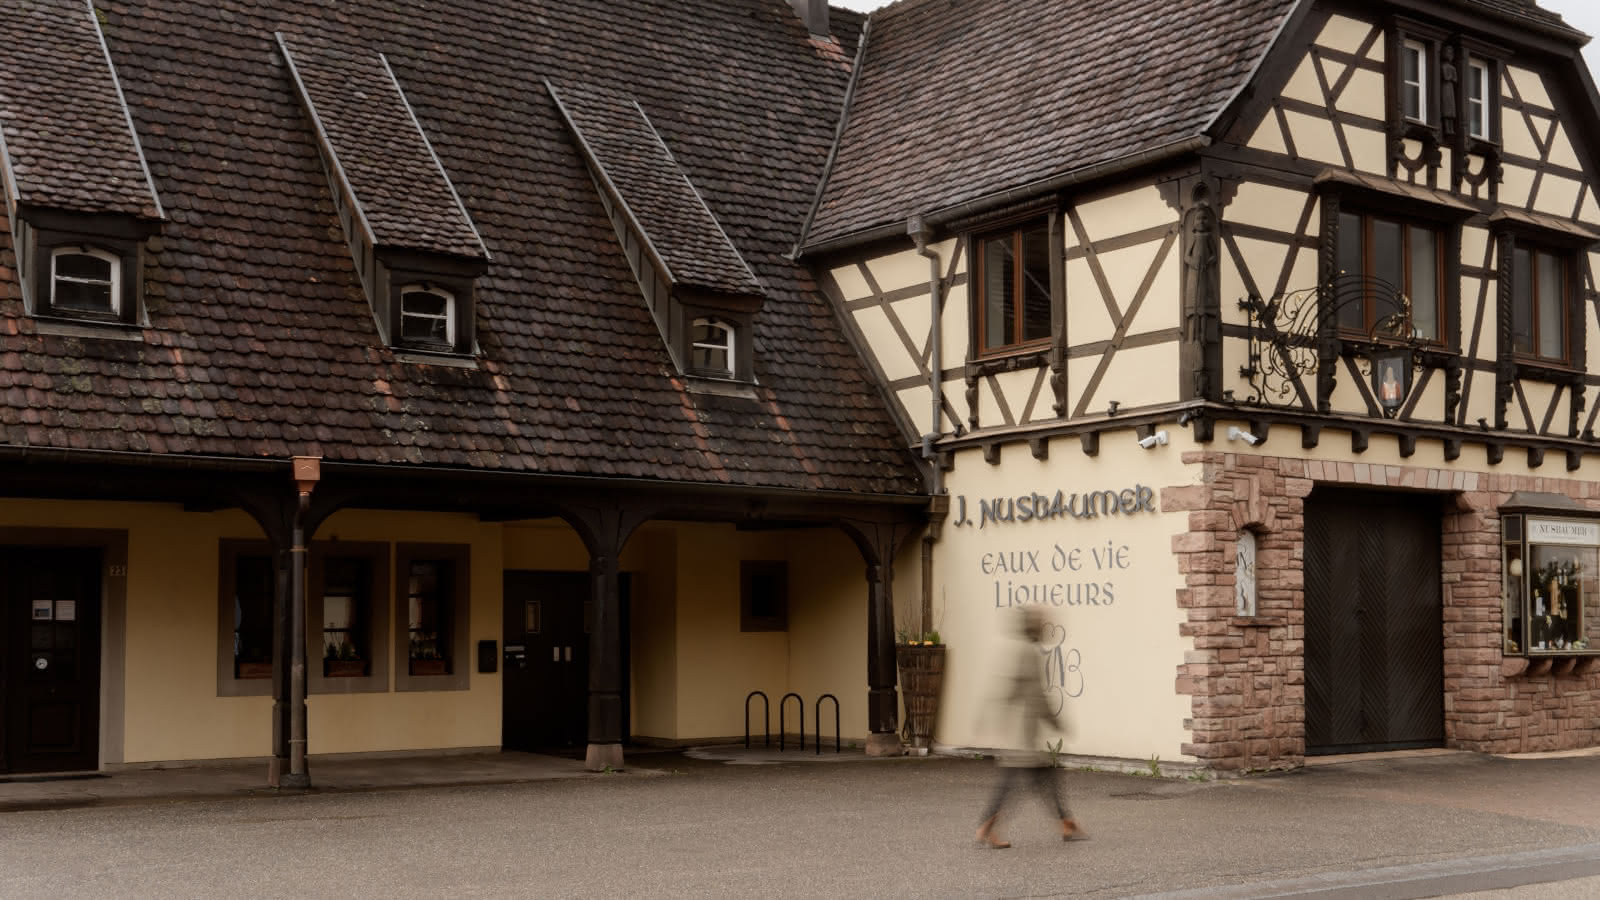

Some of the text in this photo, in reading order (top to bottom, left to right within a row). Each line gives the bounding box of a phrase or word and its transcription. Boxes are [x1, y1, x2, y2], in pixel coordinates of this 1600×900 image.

[953, 483, 1156, 530] J. NUSBAUMER
[981, 550, 1040, 575] EAUX
